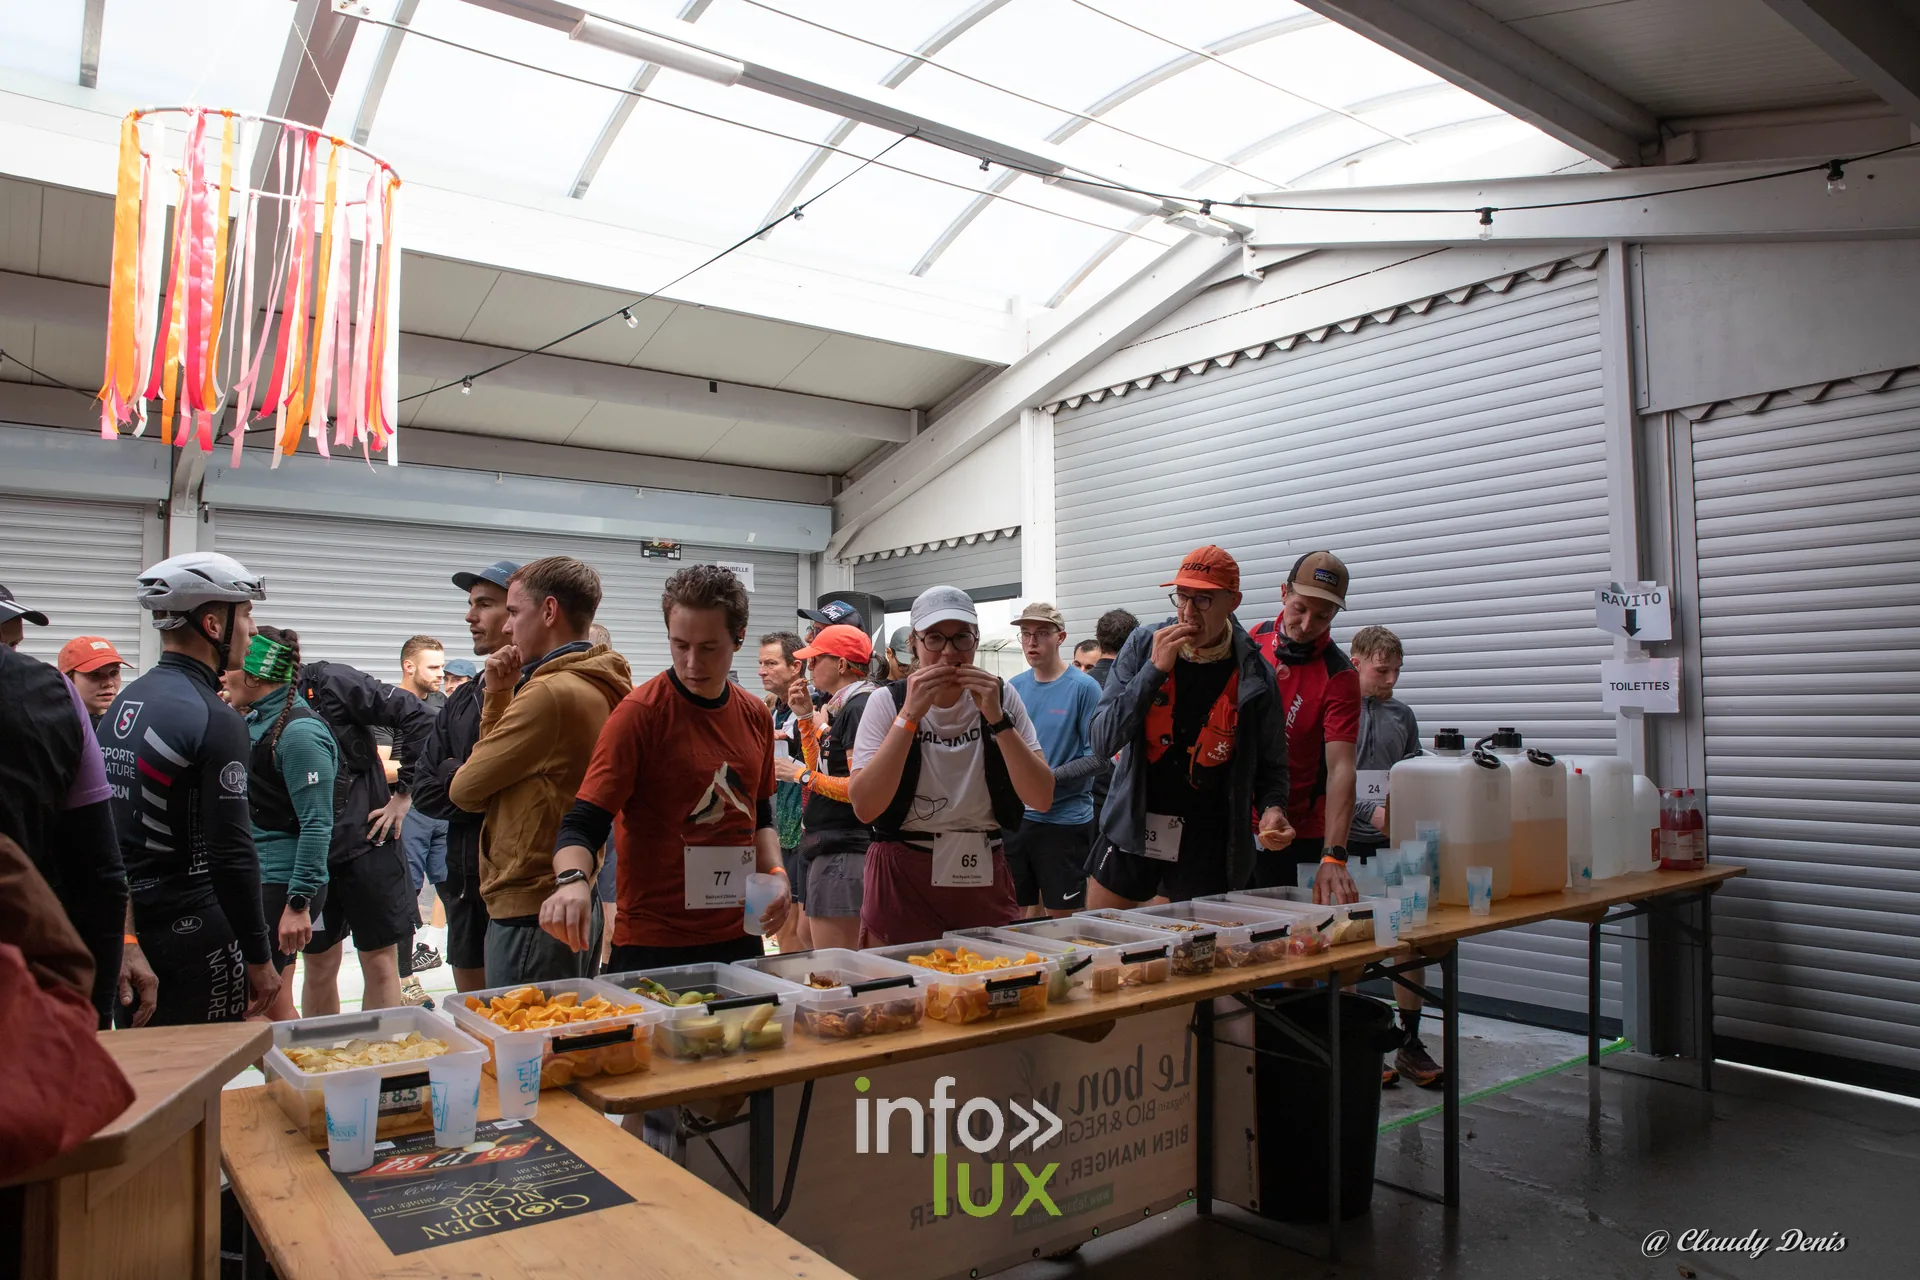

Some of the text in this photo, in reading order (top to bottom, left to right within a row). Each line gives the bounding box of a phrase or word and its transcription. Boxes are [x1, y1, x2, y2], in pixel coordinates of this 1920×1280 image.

[1601, 591, 1662, 607] RAVITO
[1610, 681, 1670, 691] TOILETTES
[1285, 693, 1303, 729] TEAM
[100, 746, 135, 764] SPORTS
[105, 762, 136, 780] ATURE
[1368, 784, 1381, 794] 24
[961, 854, 978, 868] 65
[713, 871, 731, 886] 77
[205, 948, 228, 1020] NATURE
[228, 940, 245, 1014] SPORTS
[451, 1189, 546, 1219] NIGHT
[421, 1194, 590, 1240] GOLDEN
